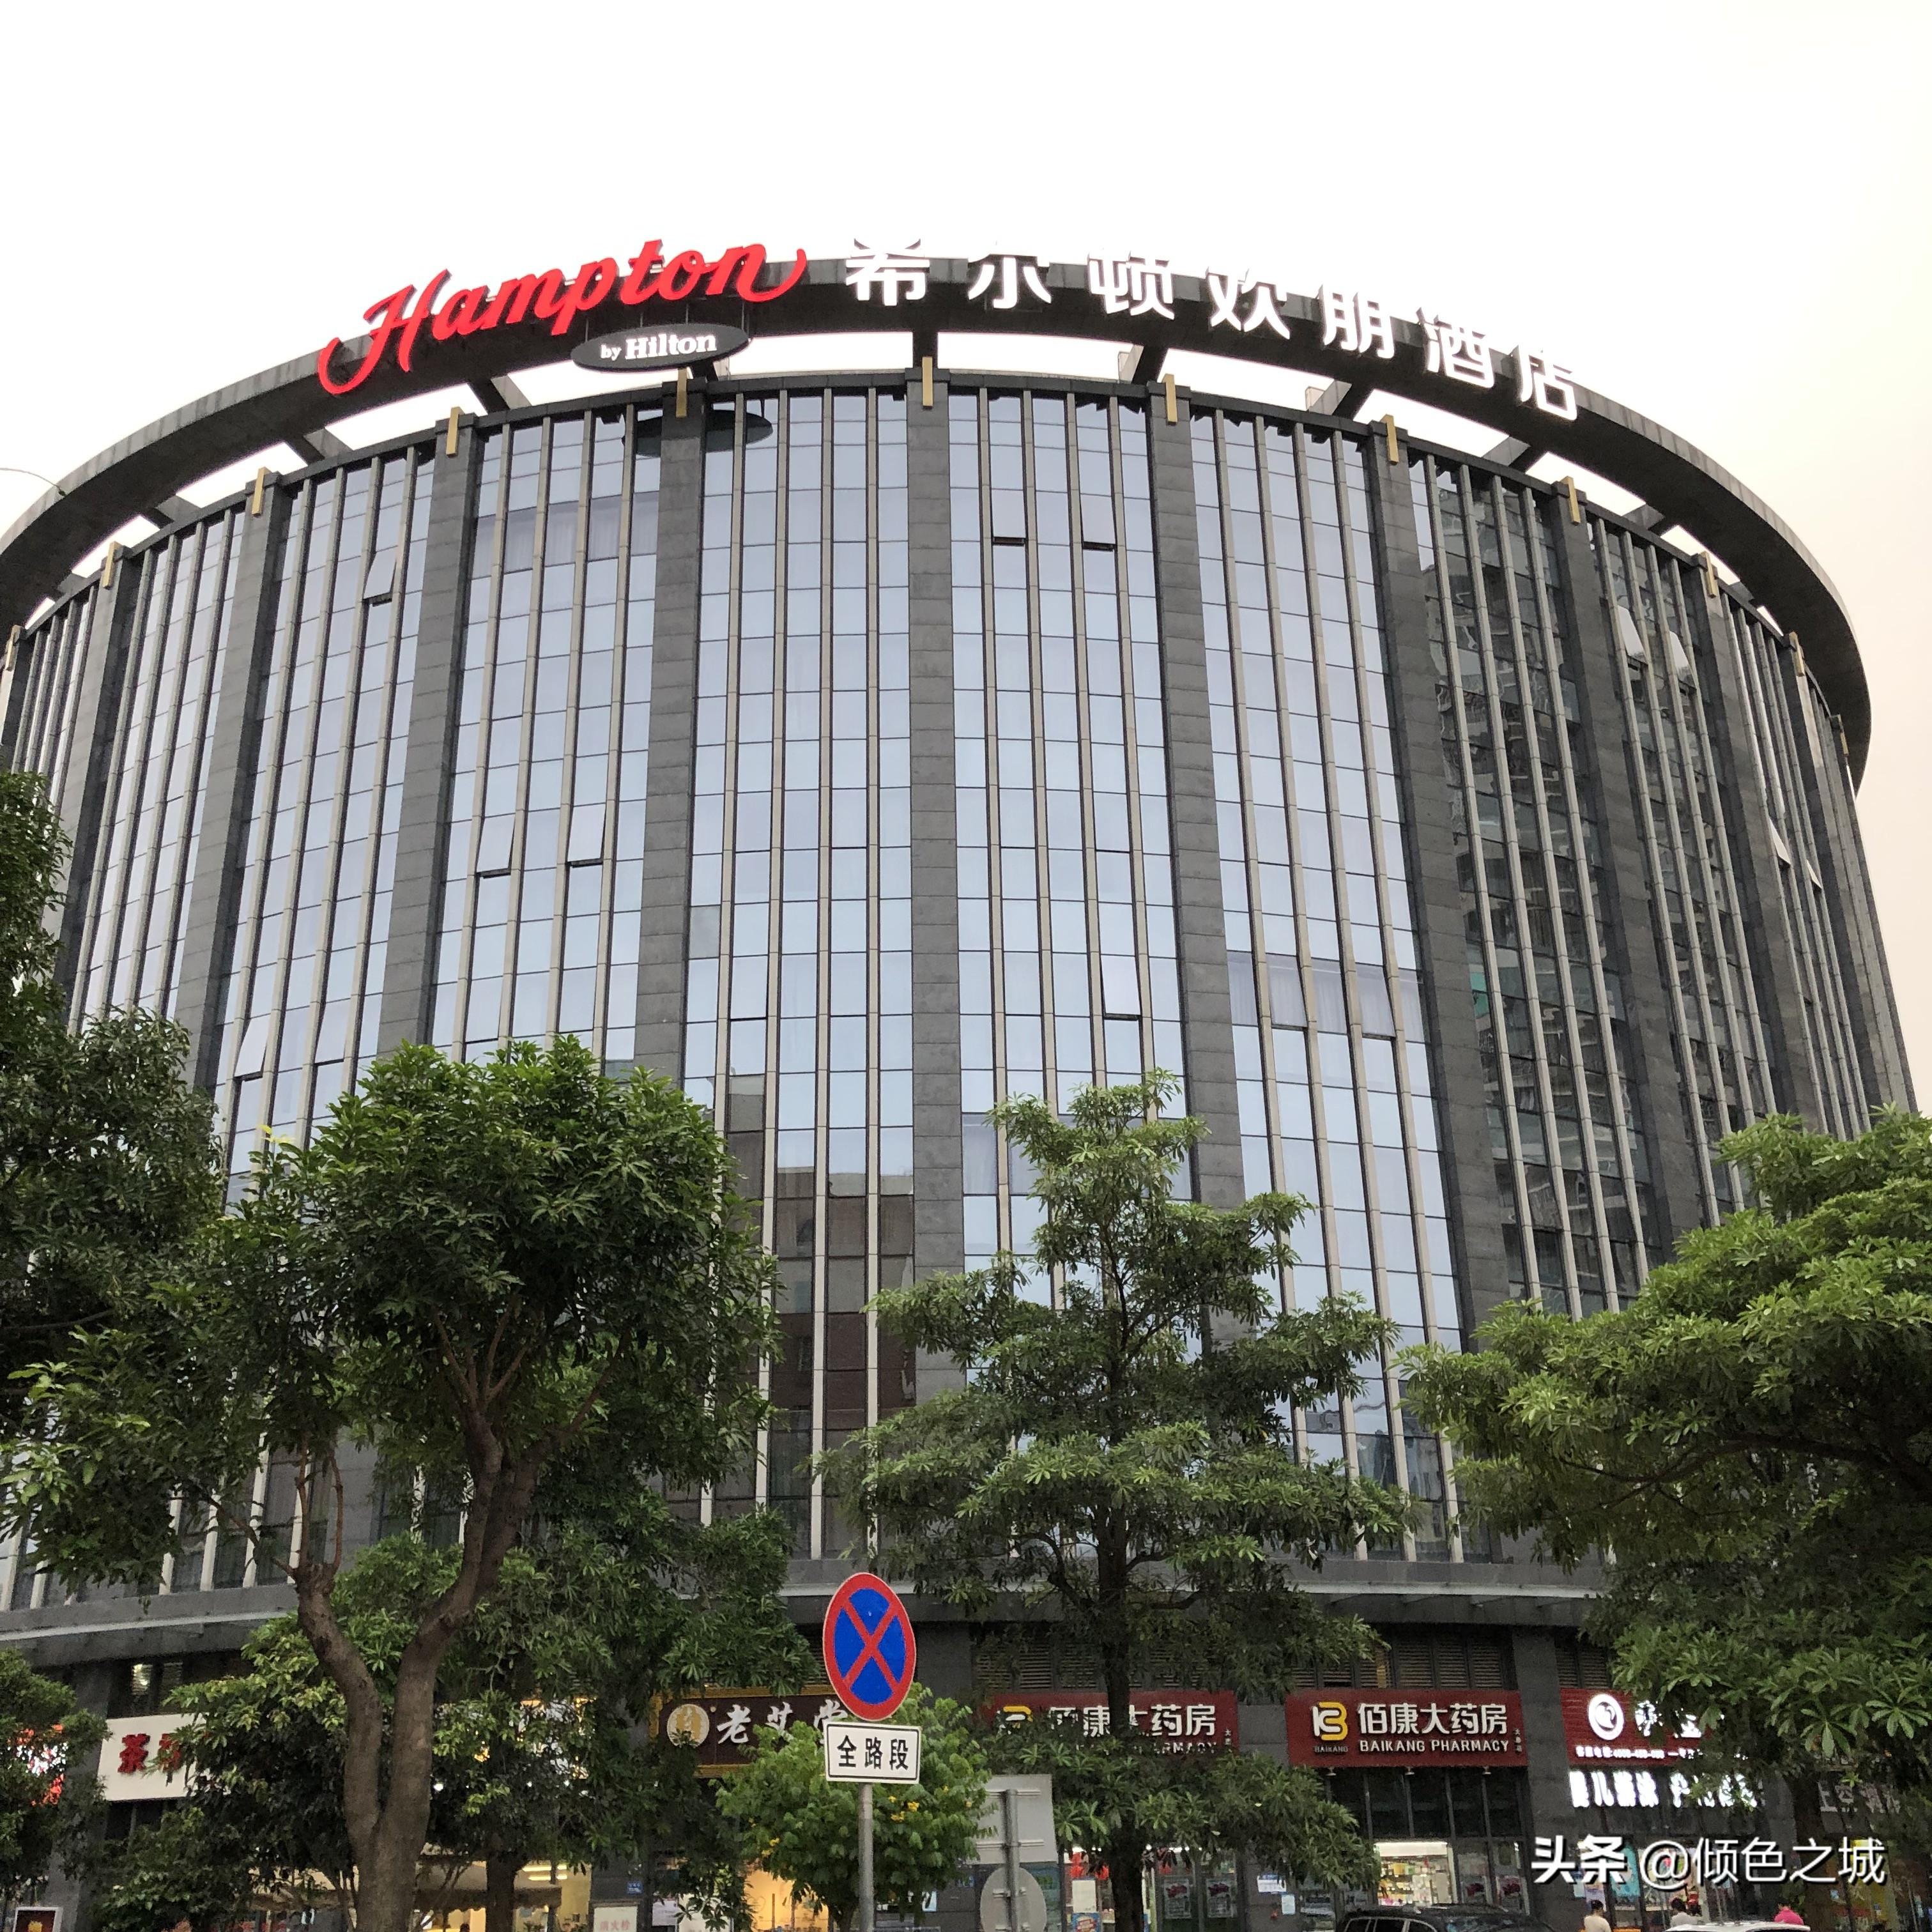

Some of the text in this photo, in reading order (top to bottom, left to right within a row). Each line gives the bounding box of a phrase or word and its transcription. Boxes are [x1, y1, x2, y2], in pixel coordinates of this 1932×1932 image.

[318, 240, 807, 394] Hampton
[845, 238, 1577, 420] 希尔顿欢朋酒店
[599, 333, 717, 360] by Hilton
[1358, 1703, 1507, 1734] 佰康大药房
[838, 1735, 908, 1770] 全路段
[1360, 1740, 1425, 1751] BAIKANG
[1432, 1740, 1508, 1751] PHARMACY
